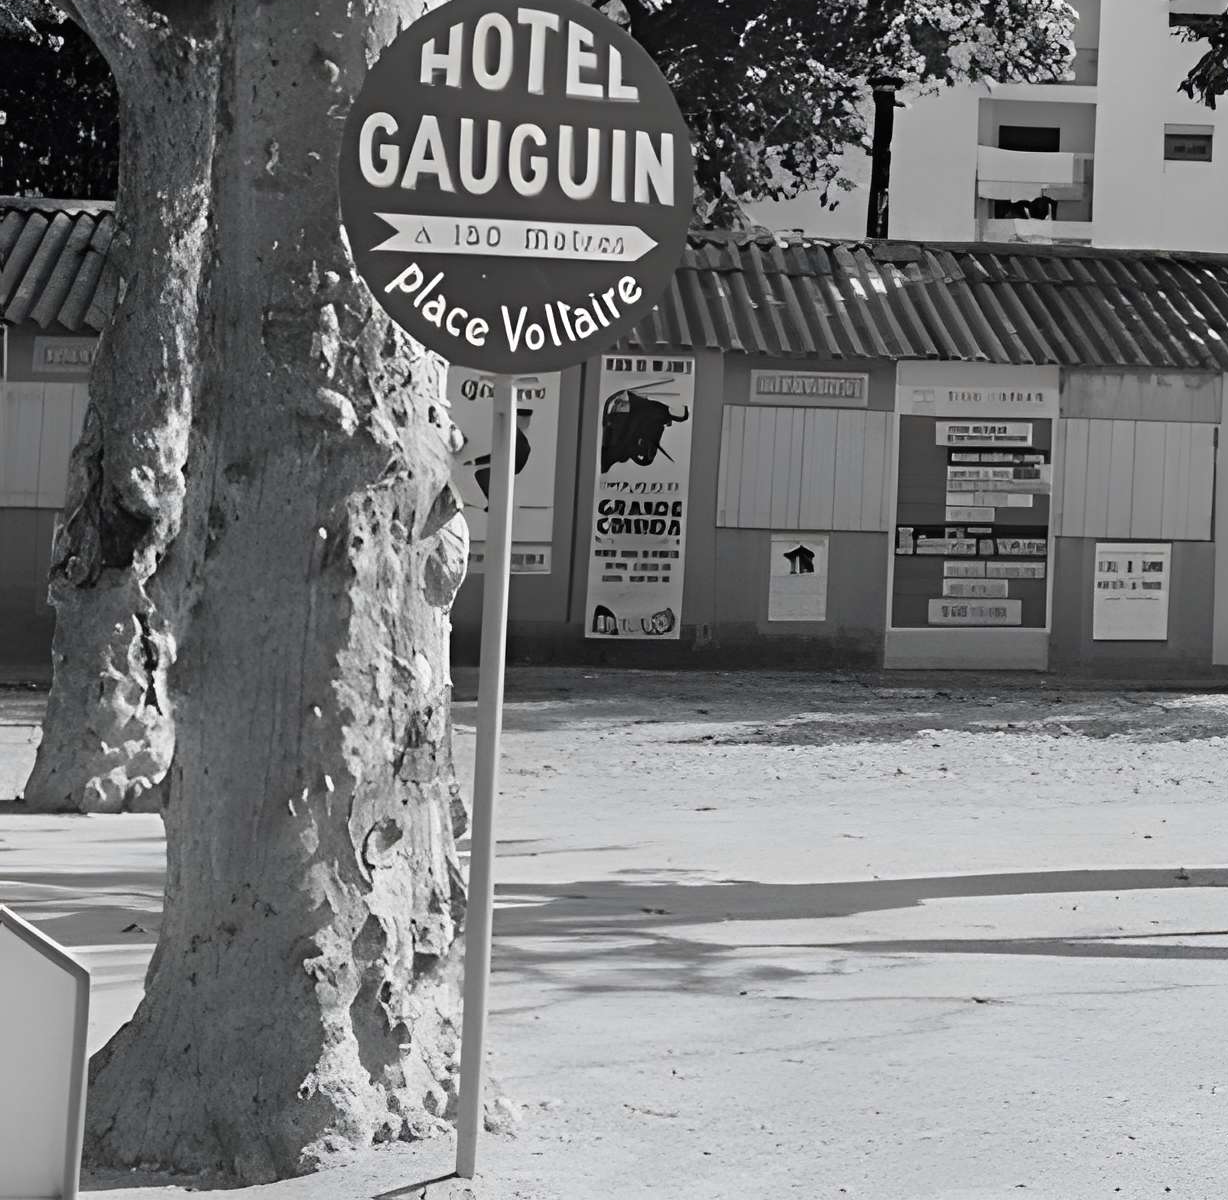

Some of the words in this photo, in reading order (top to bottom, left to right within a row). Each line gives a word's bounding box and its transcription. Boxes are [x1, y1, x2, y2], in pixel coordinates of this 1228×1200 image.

[419, 7, 640, 103] HOTEL
[358, 111, 675, 207] GAUGUIN
[501, 275, 643, 353] Voltaire
